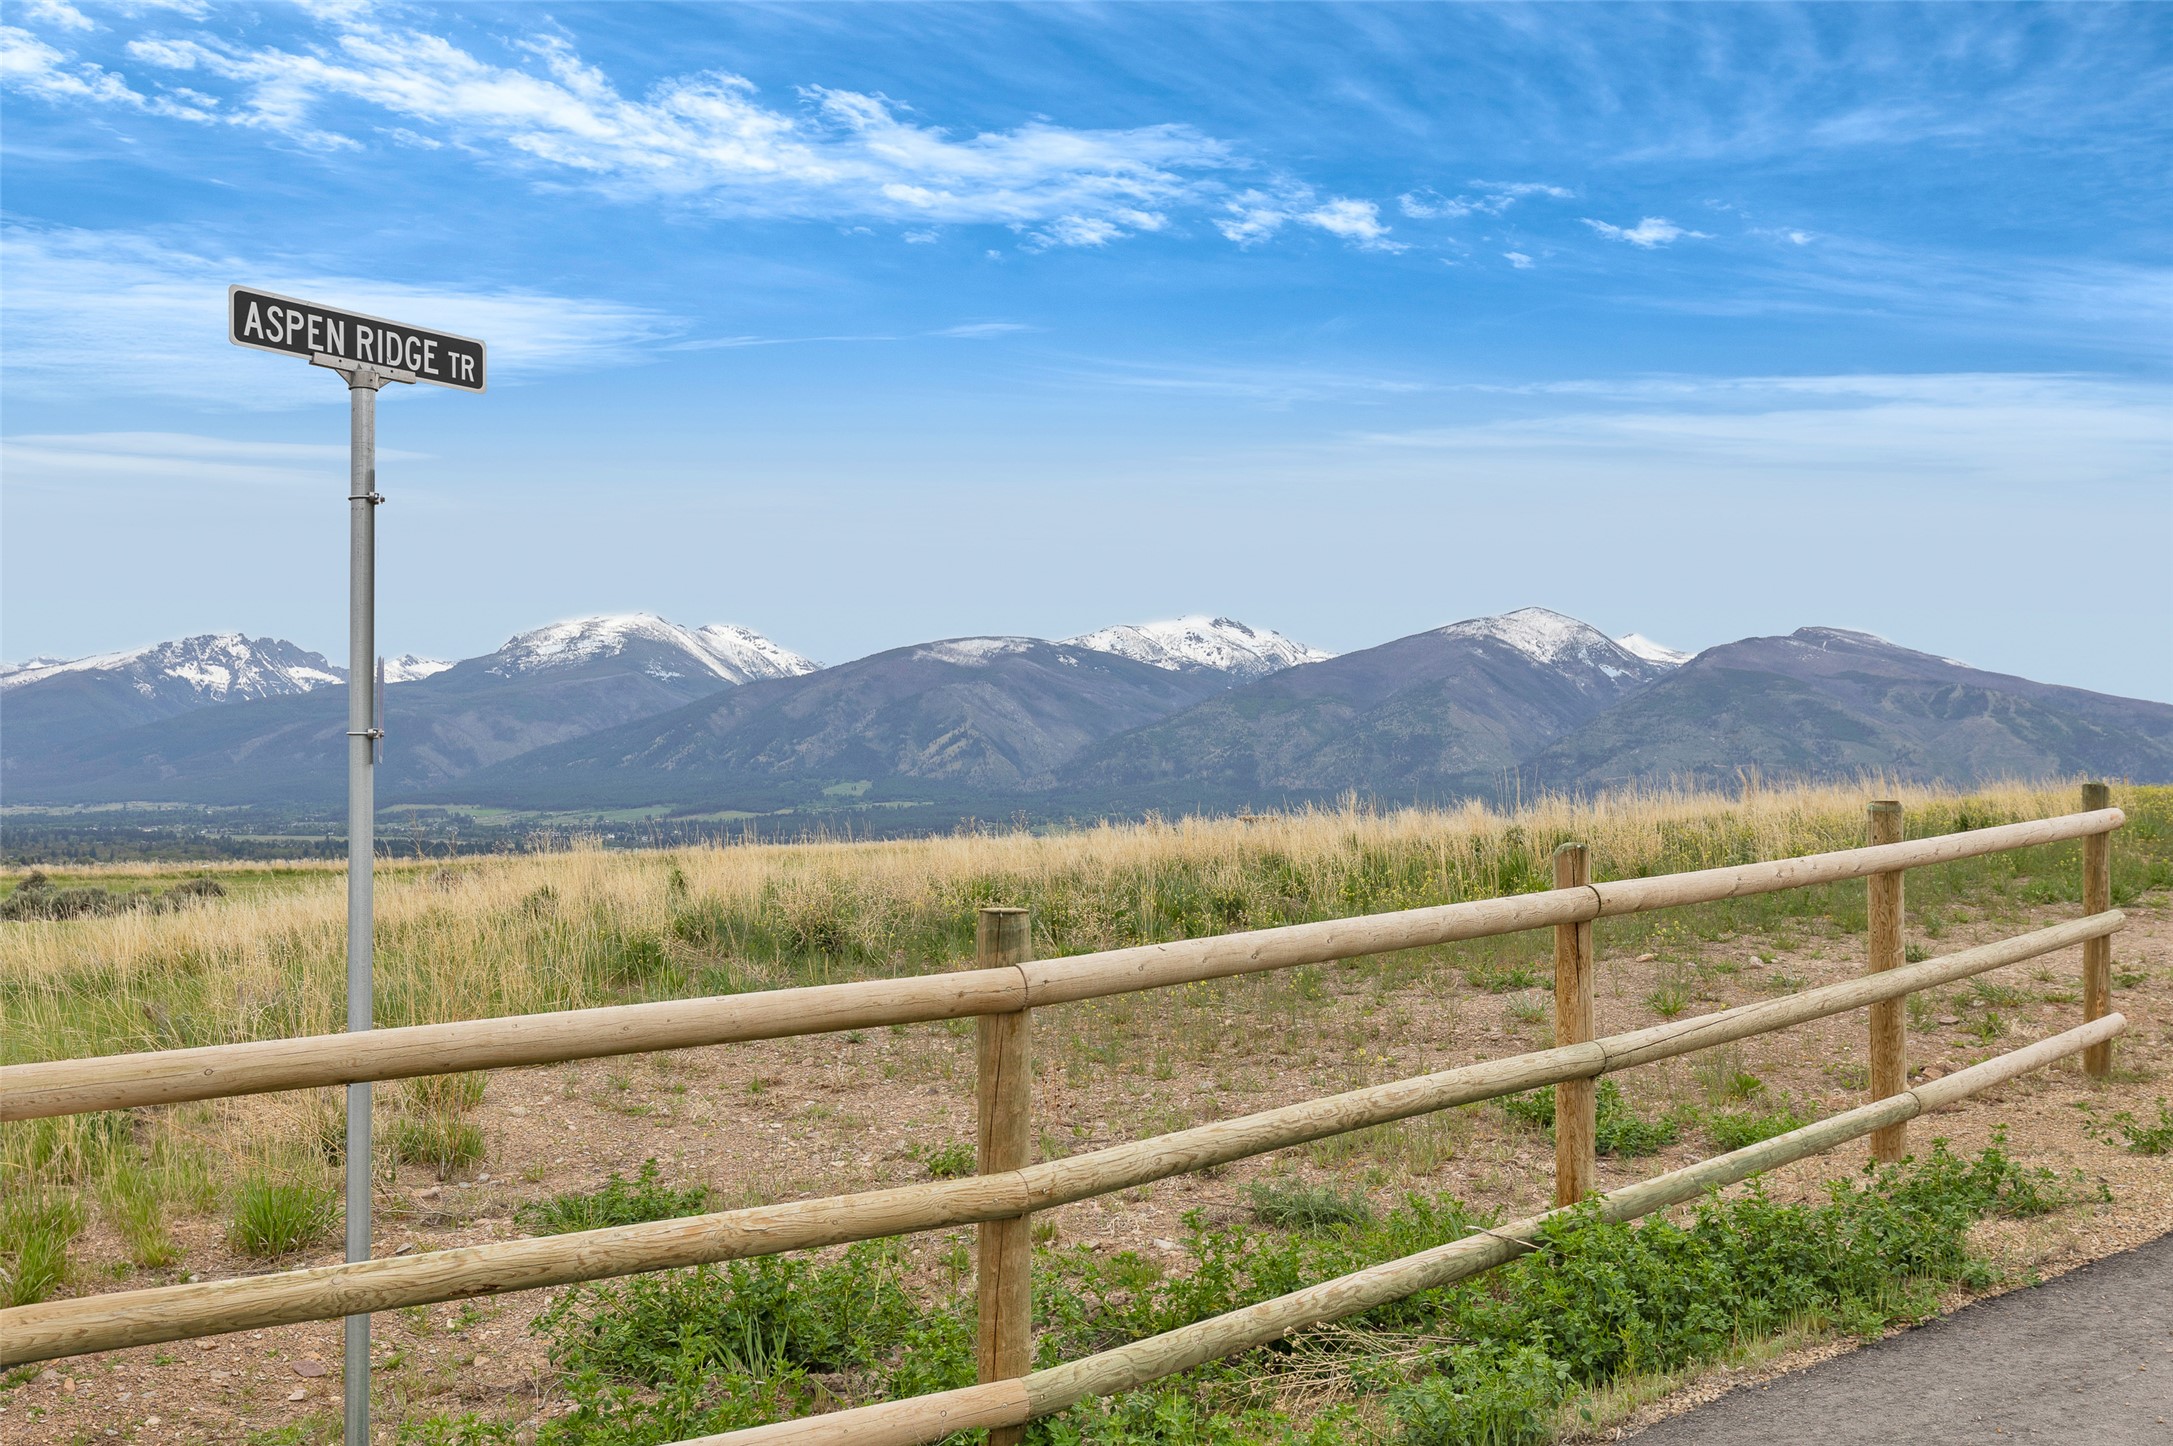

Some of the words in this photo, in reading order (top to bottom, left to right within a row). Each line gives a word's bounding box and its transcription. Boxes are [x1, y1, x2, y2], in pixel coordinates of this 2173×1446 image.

[243, 301, 345, 356] ASPEN
[356, 324, 439, 375] RIDGE
[448, 351, 475, 382] TR
